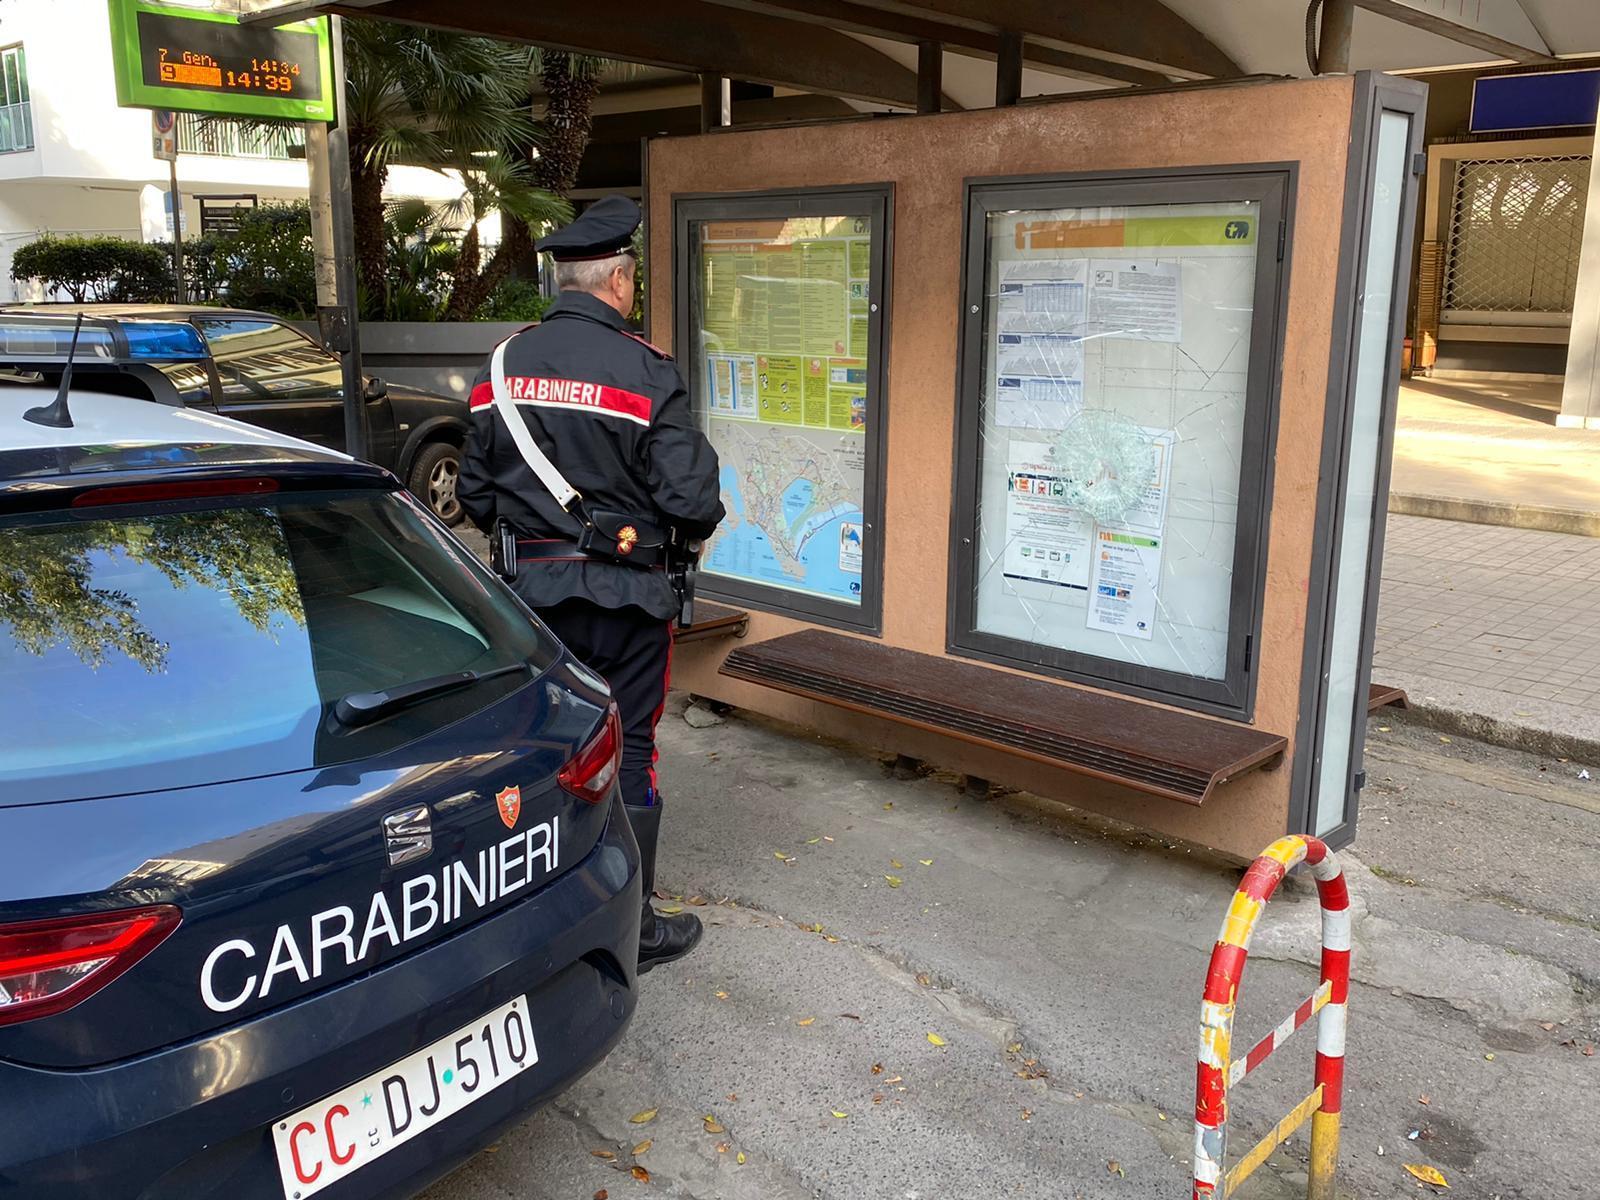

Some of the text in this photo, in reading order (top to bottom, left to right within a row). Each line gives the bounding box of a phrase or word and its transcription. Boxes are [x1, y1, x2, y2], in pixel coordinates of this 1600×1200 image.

[159, 48, 301, 76] 7 Gen. 14:34
[162, 64, 292, 92] 9 14:39
[504, 377, 603, 406] ARABINIERI
[200, 816, 560, 1013] CARABINIERI
[289, 1010, 527, 1185] CC DJ 510
